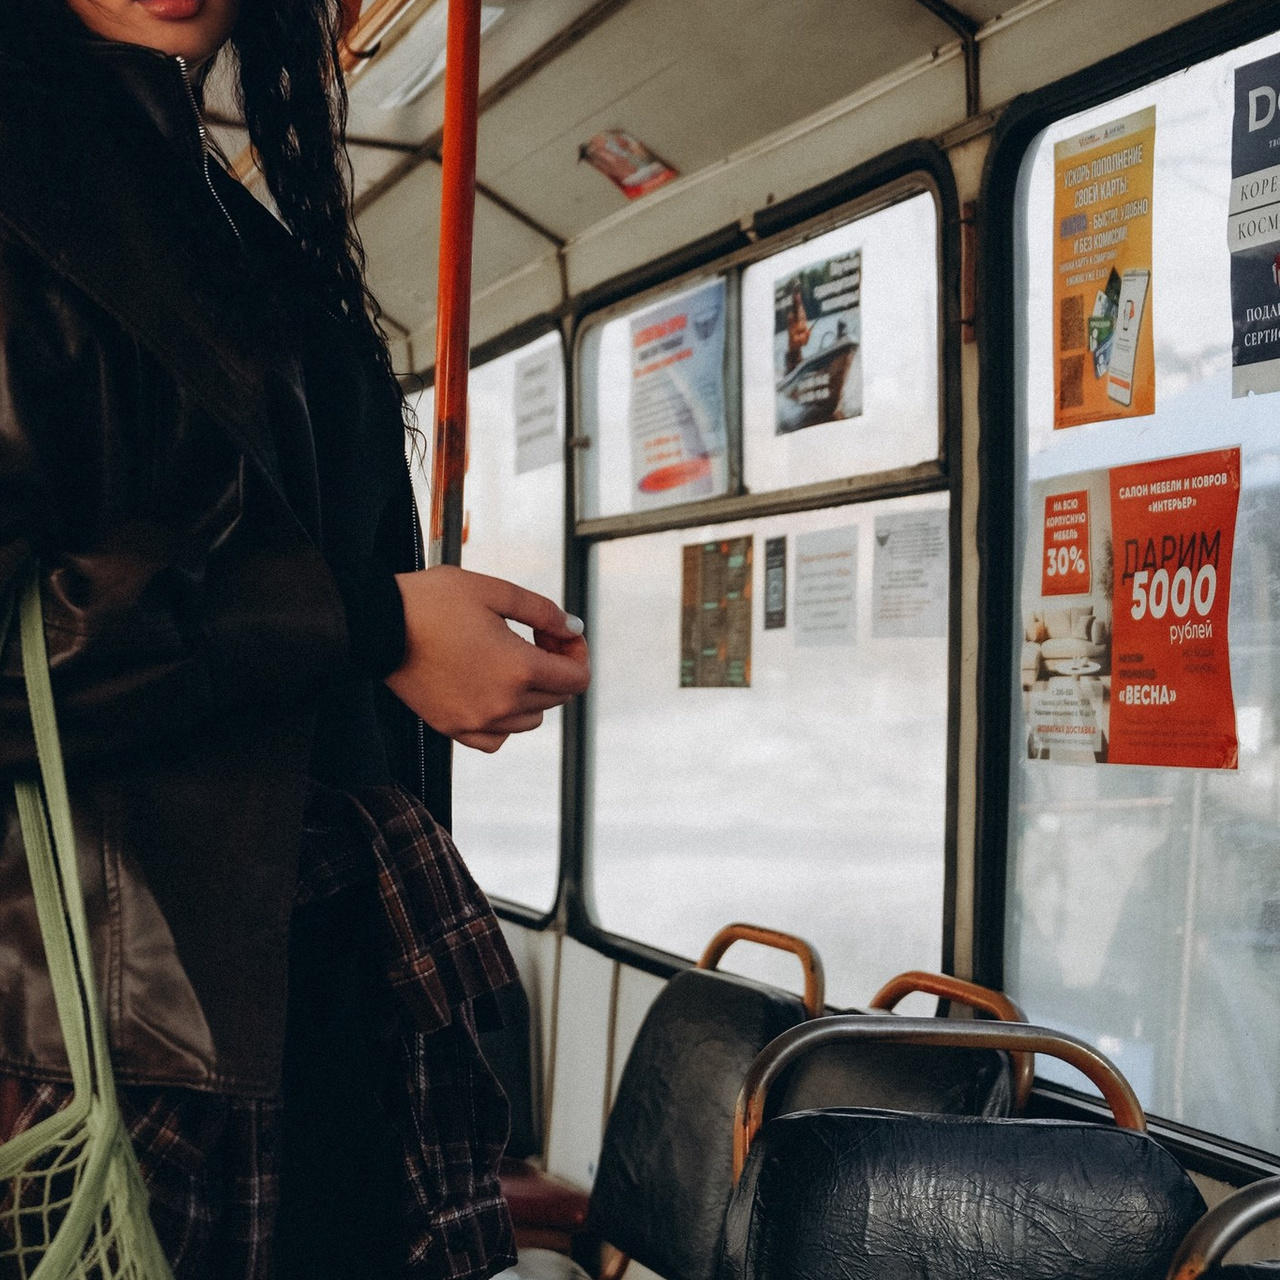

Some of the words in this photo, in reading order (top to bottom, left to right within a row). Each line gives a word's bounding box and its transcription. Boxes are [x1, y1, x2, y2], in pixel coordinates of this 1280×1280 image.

[1064, 164, 1090, 189] УСКОРЬ
[1091, 144, 1143, 178] ПОПОЛНЕНИЕ
[1075, 181, 1099, 209] СВОЕЙ
[1121, 198, 1149, 221] УДОБНО
[1080, 236, 1093, 253] БЕЗ
[1246, 303, 1280, 322] ПОДА
[1244, 328, 1280, 347] СЕРТИ
[1119, 484, 1149, 500] САЛОН
[1150, 479, 1182, 495] МЕБЕЛИ
[1184, 478, 1190, 490] И
[1191, 472, 1228, 489] КОВРОВ
[1053, 501, 1063, 512] НА
[1063, 498, 1079, 510] ВСЮ
[1148, 496, 1197, 513] «ИНТЕРЬЕР»
[1046, 512, 1086, 528] КОРПУСНУЮ
[1053, 529, 1079, 541] МЕБЕЛЬ
[1047, 545, 1086, 577] 30%
[1122, 527, 1221, 586] ДАРИМ
[1131, 564, 1217, 620] 5000
[1170, 620, 1213, 645] рублей
[1119, 684, 1177, 706] «ВЕСНА»
[1066, 725, 1097, 735] ДОСТАВКА
